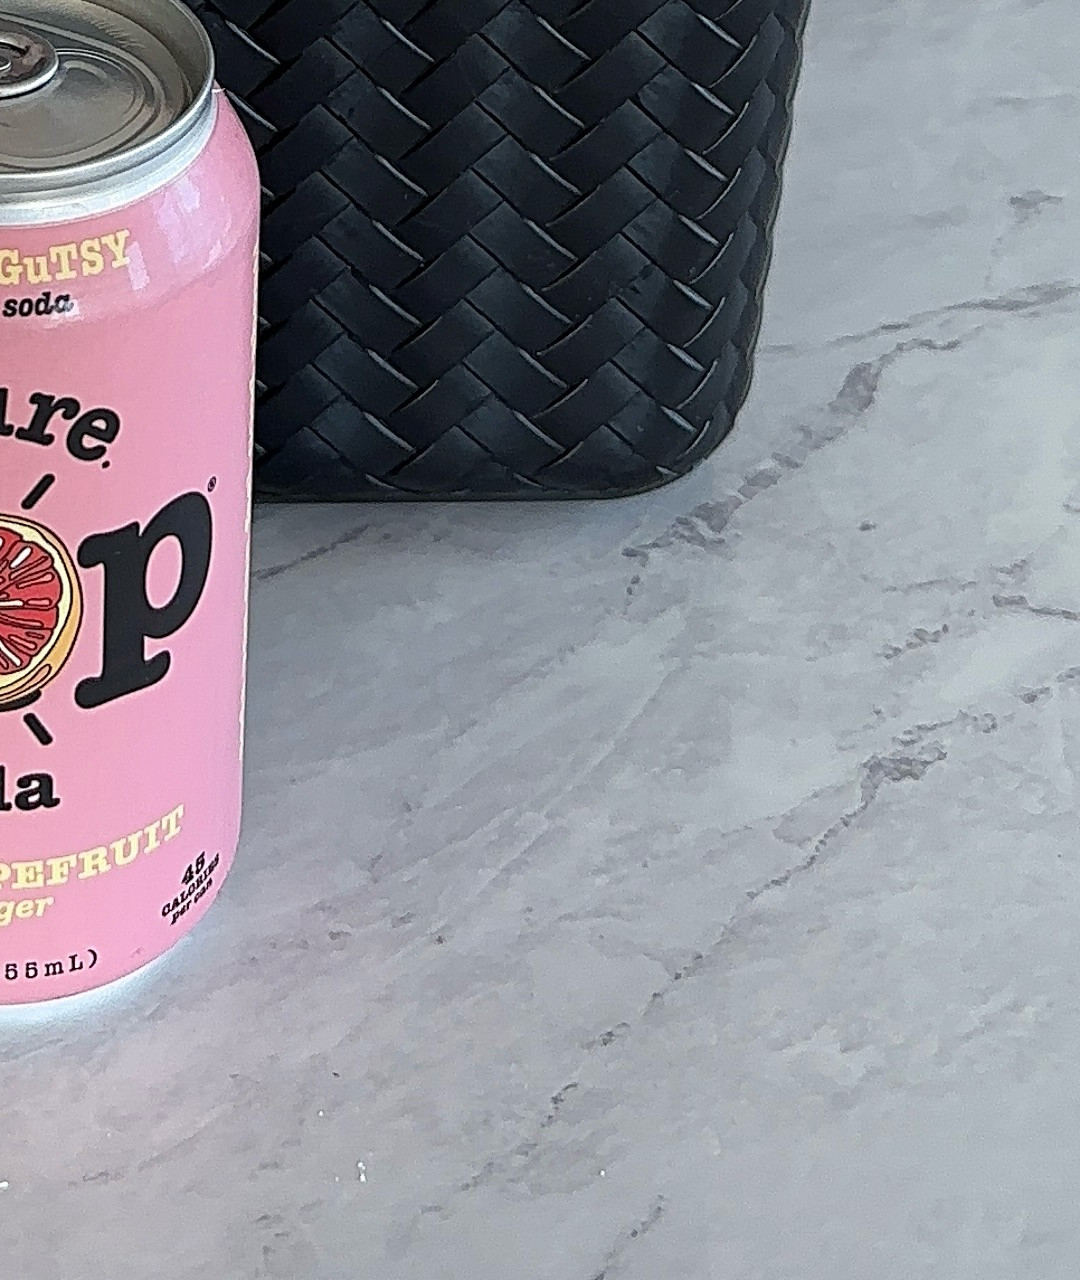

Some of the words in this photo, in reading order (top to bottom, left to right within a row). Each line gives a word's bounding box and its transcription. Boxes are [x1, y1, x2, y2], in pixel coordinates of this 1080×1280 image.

[1, 291, 74, 317] soda
[161, 853, 220, 917] CALORIES
[170, 899, 192, 927] per
[193, 877, 213, 903] can
